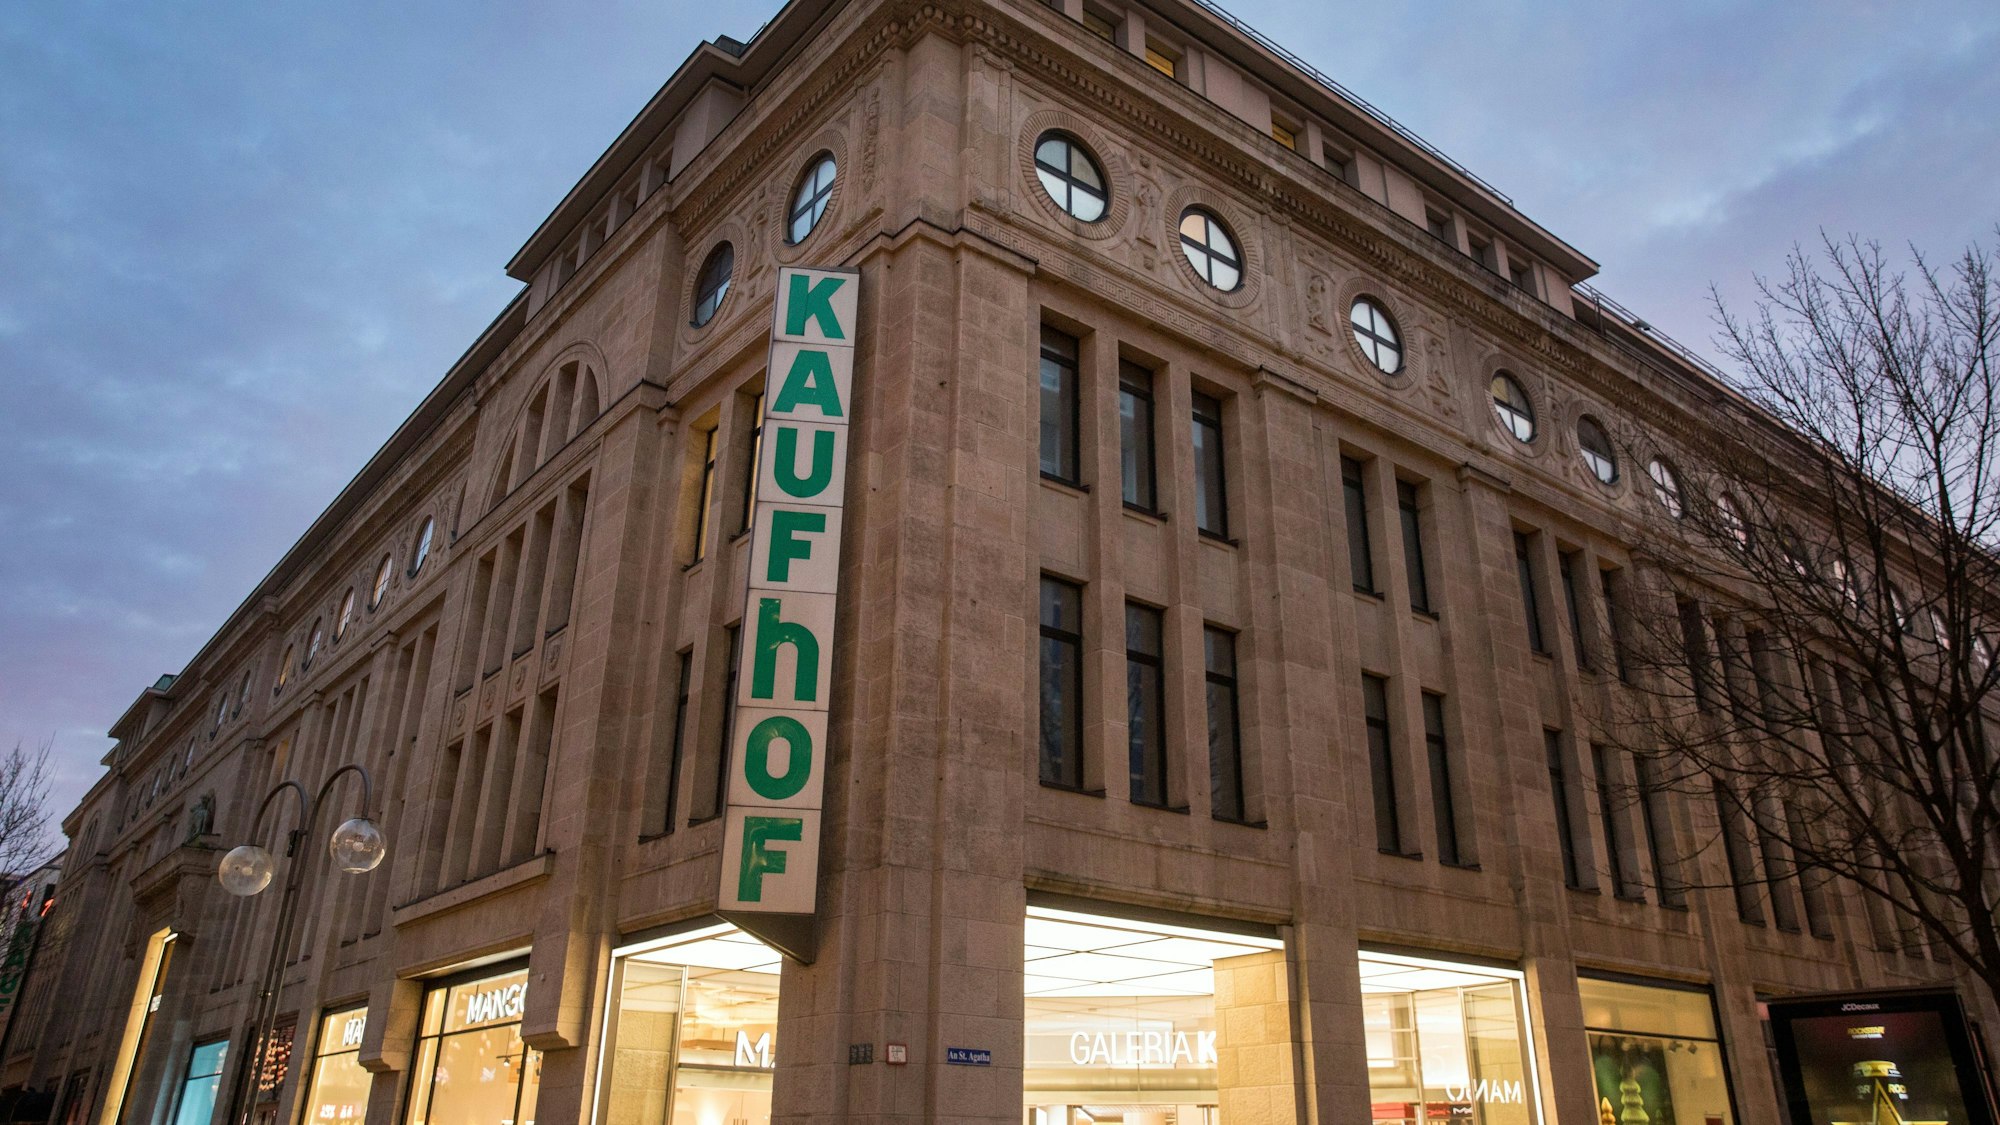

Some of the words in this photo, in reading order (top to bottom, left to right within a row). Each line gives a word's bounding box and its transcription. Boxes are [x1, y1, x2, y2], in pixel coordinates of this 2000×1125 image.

[1841, 1003, 1880, 1012] JCDecaux
[735, 1030, 776, 1069] M
[949, 1051, 958, 1060] An
[969, 1052, 990, 1063] Agatha
[1070, 1031, 1194, 1065] GALERIA
